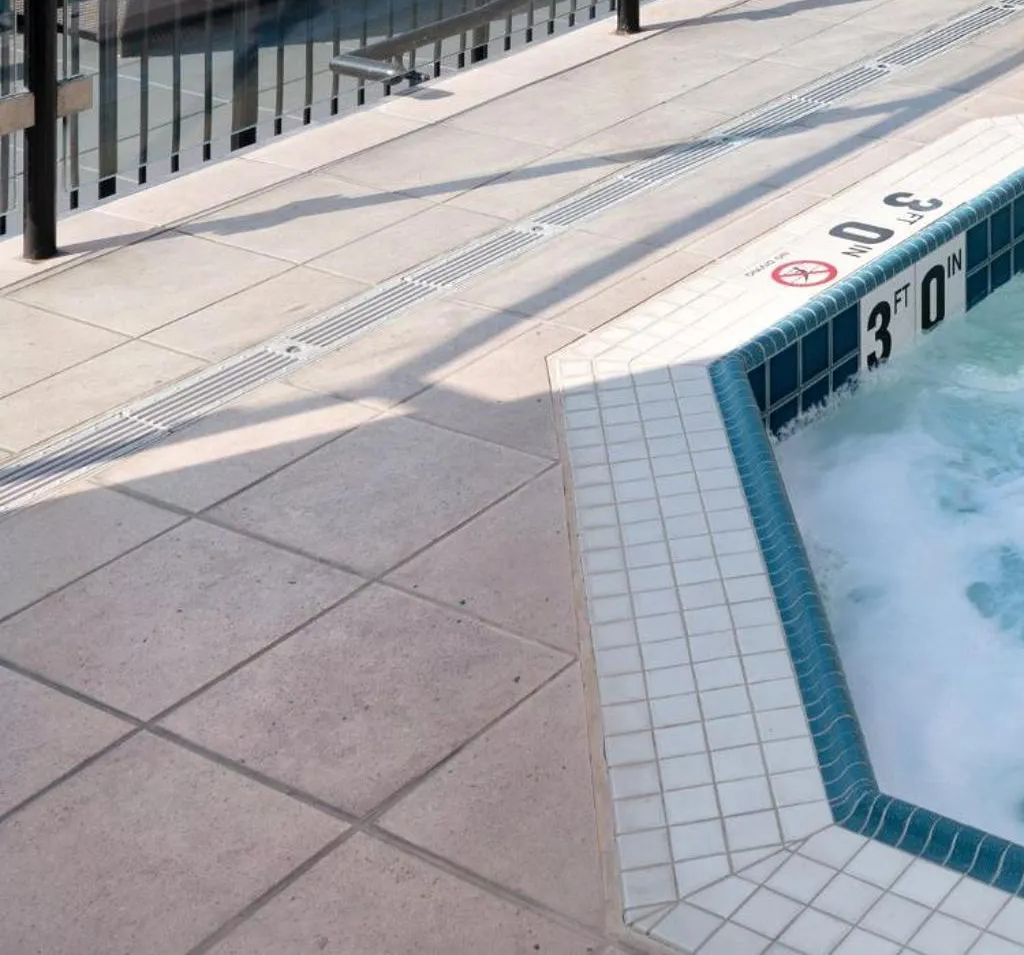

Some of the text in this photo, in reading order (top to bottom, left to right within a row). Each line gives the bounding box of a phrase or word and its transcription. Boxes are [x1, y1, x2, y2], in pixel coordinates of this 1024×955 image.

[883, 192, 943, 225] 3 FT
[828, 221, 894, 258] 0 IN
[867, 249, 962, 371] 3 FT 0 IN
